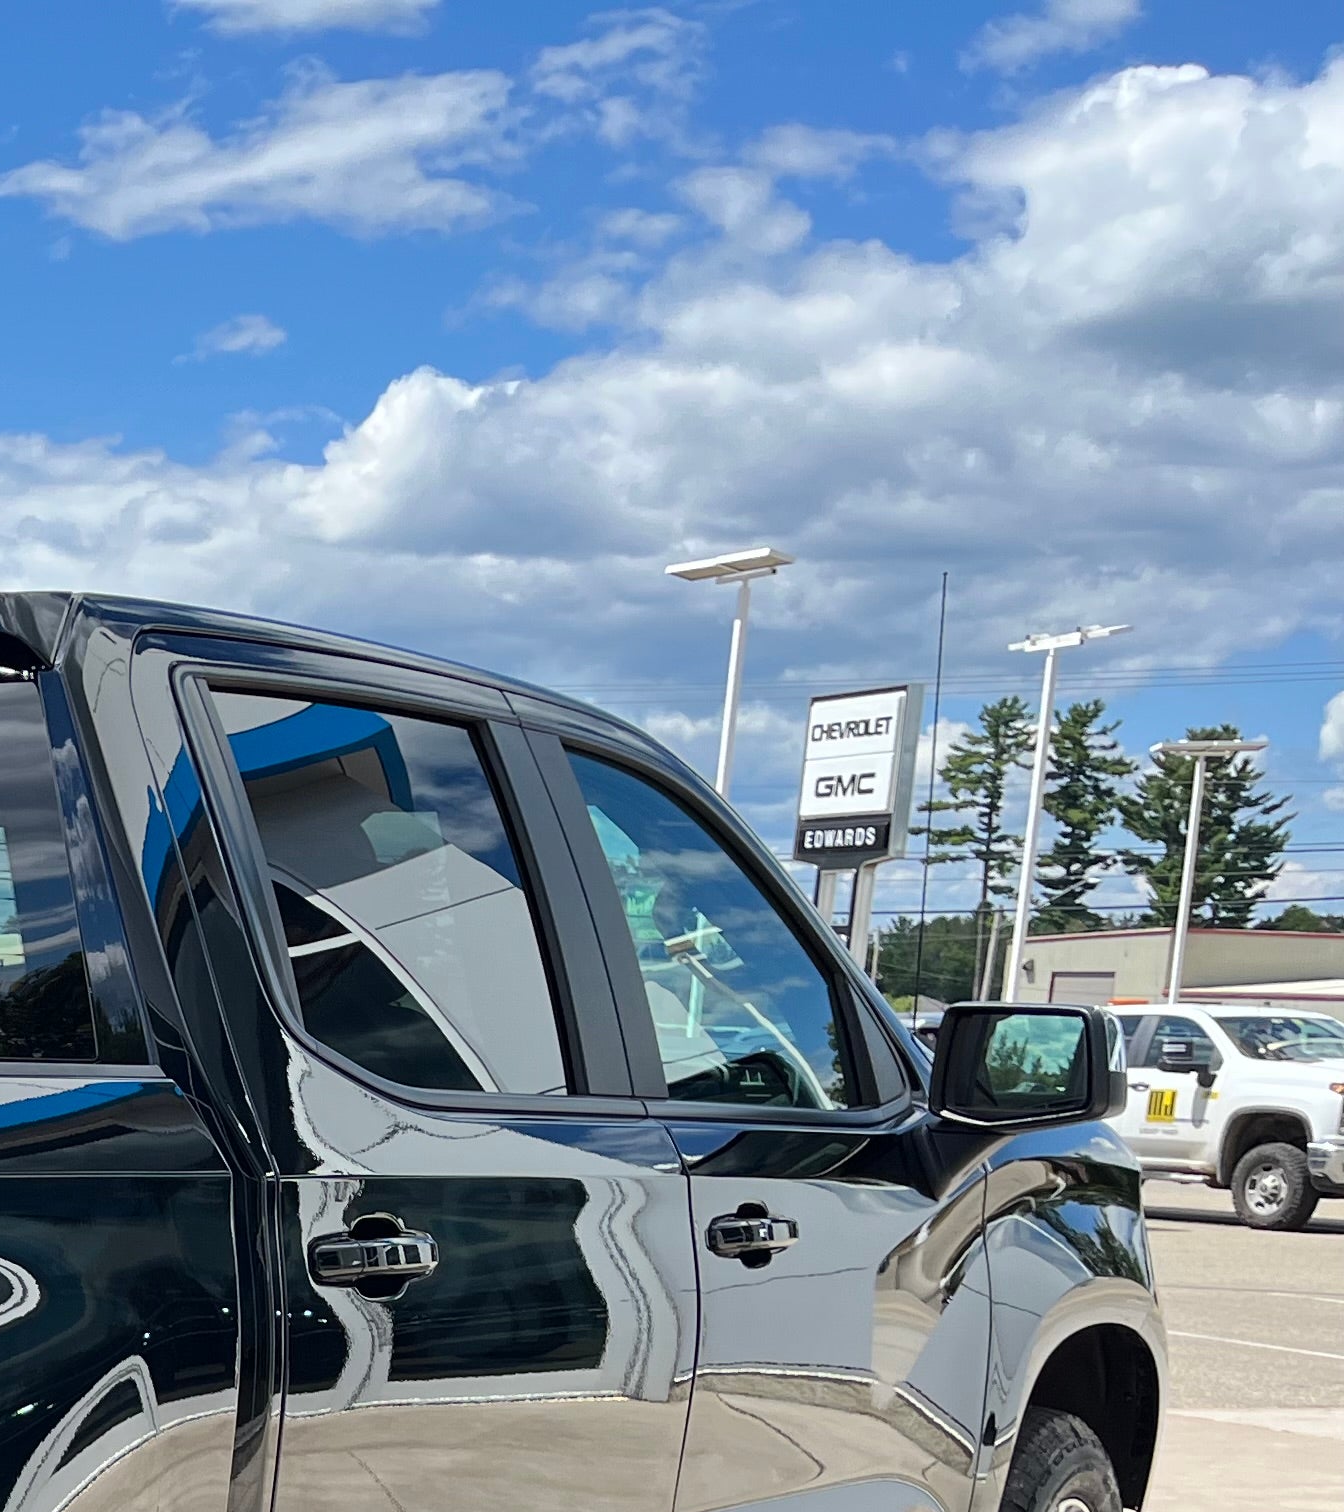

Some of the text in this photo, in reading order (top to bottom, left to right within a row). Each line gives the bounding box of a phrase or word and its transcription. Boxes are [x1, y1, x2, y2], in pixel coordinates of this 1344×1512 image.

[812, 716, 893, 742] CHEVROLET
[815, 772, 876, 797] GMC
[803, 827, 876, 849] EDWARDS
